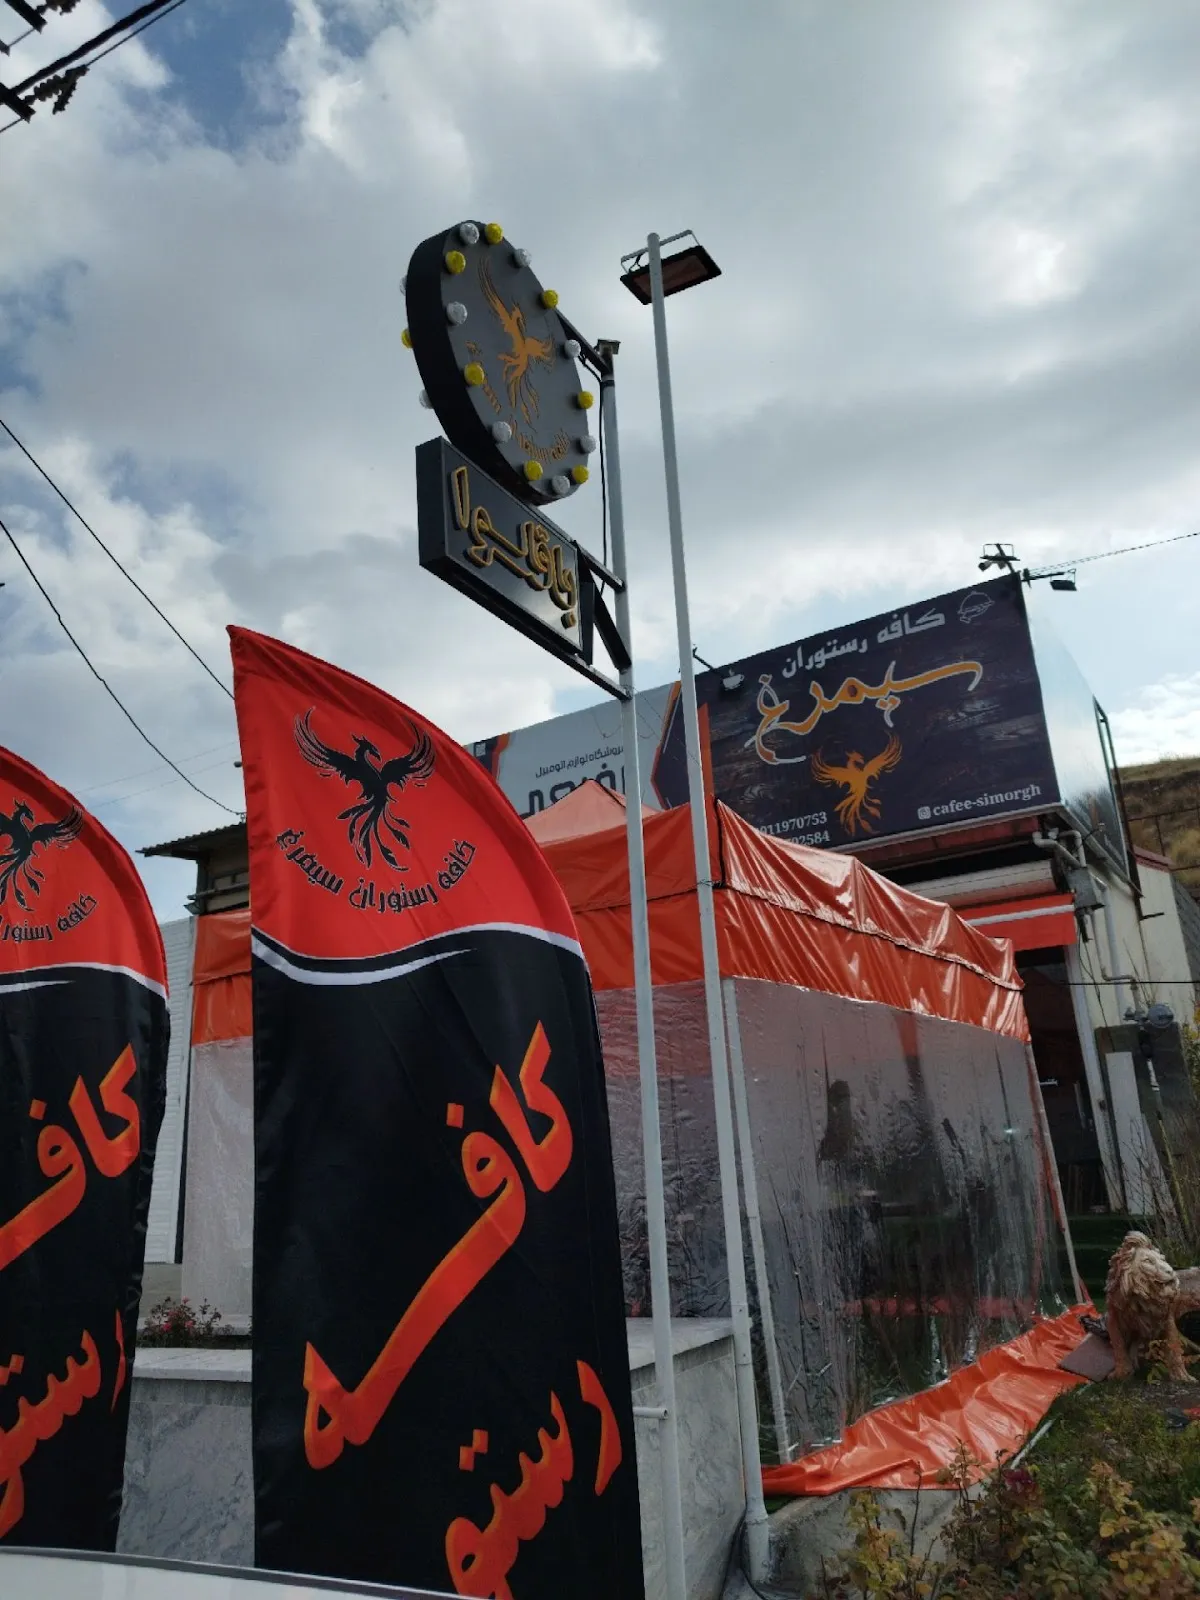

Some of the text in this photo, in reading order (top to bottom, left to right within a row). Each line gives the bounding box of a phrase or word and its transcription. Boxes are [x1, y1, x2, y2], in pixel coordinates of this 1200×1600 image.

[782, 607, 946, 680] کافه رستوران
[744, 660, 984, 766] سیمرغ
[756, 811, 828, 836] 011970753
[933, 784, 1041, 816] cafee-simorgh
[438, 838, 478, 891] کافه
[348, 877, 439, 914] رستوران
[303, 1020, 573, 1470] کافه
